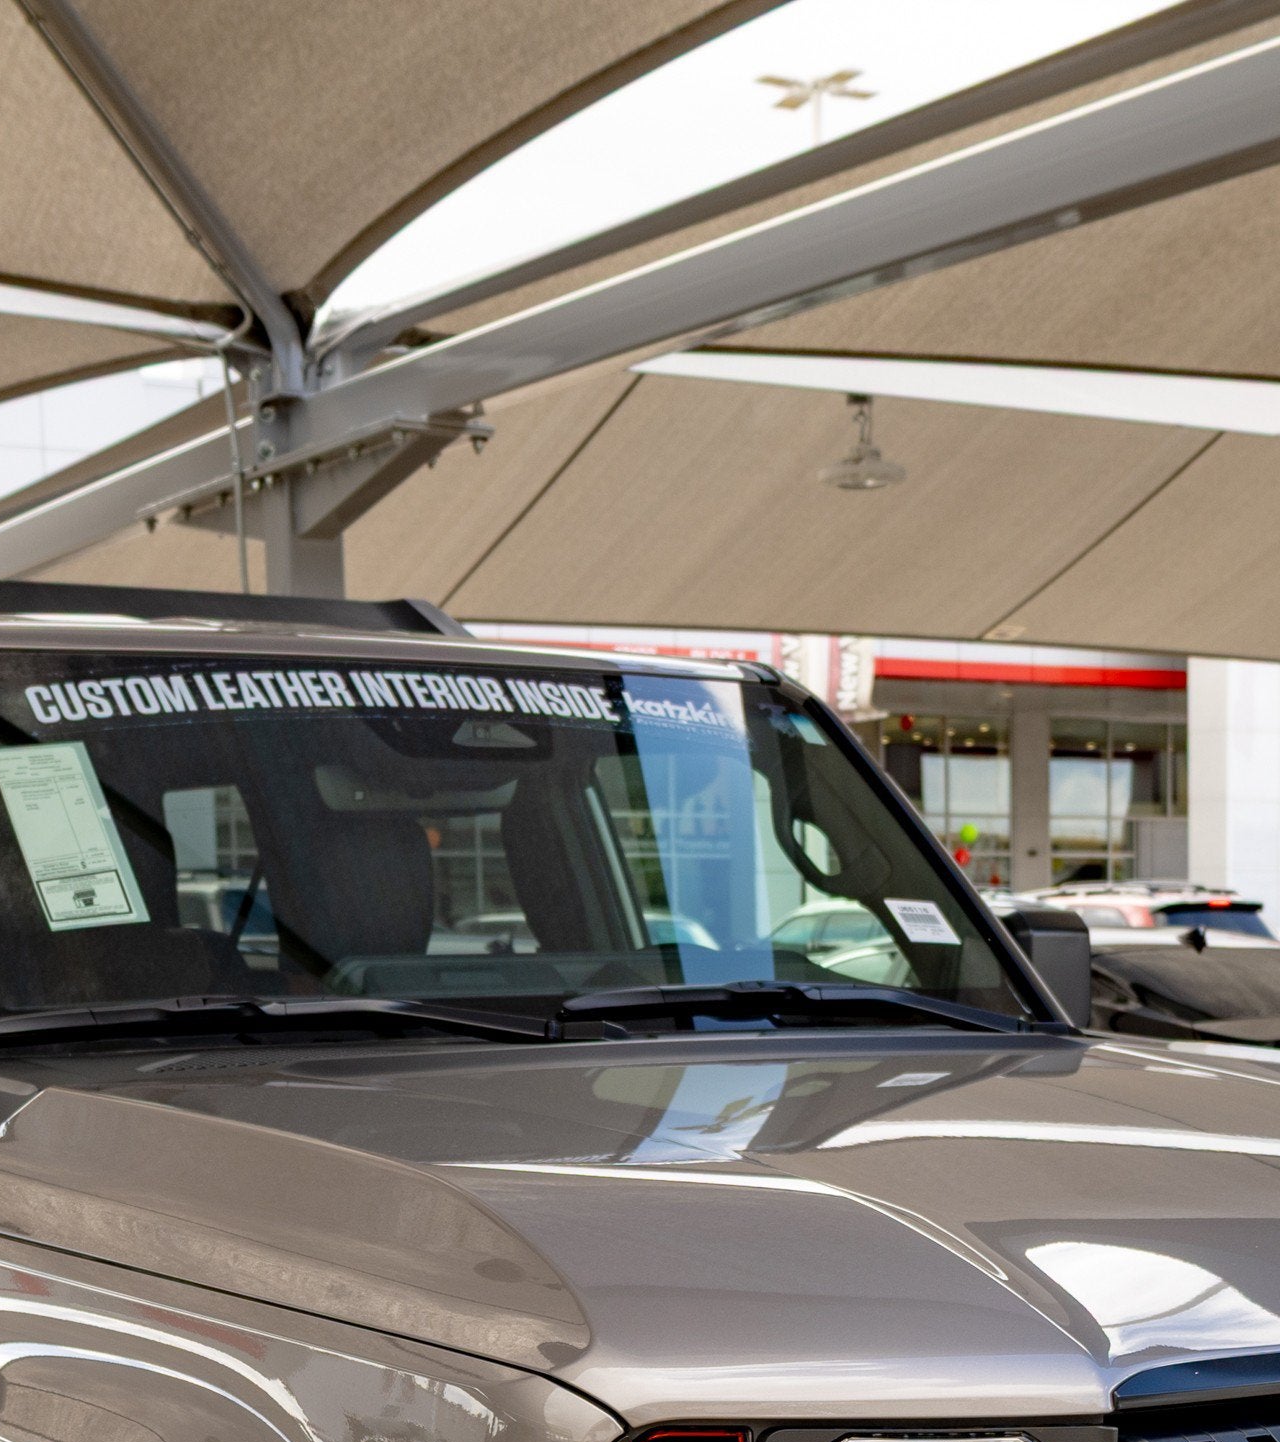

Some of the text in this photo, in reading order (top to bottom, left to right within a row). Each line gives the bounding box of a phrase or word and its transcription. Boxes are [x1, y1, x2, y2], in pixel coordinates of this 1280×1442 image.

[24, 671, 621, 724] CUSTOM LEATHER INTERIOR INSIDE
